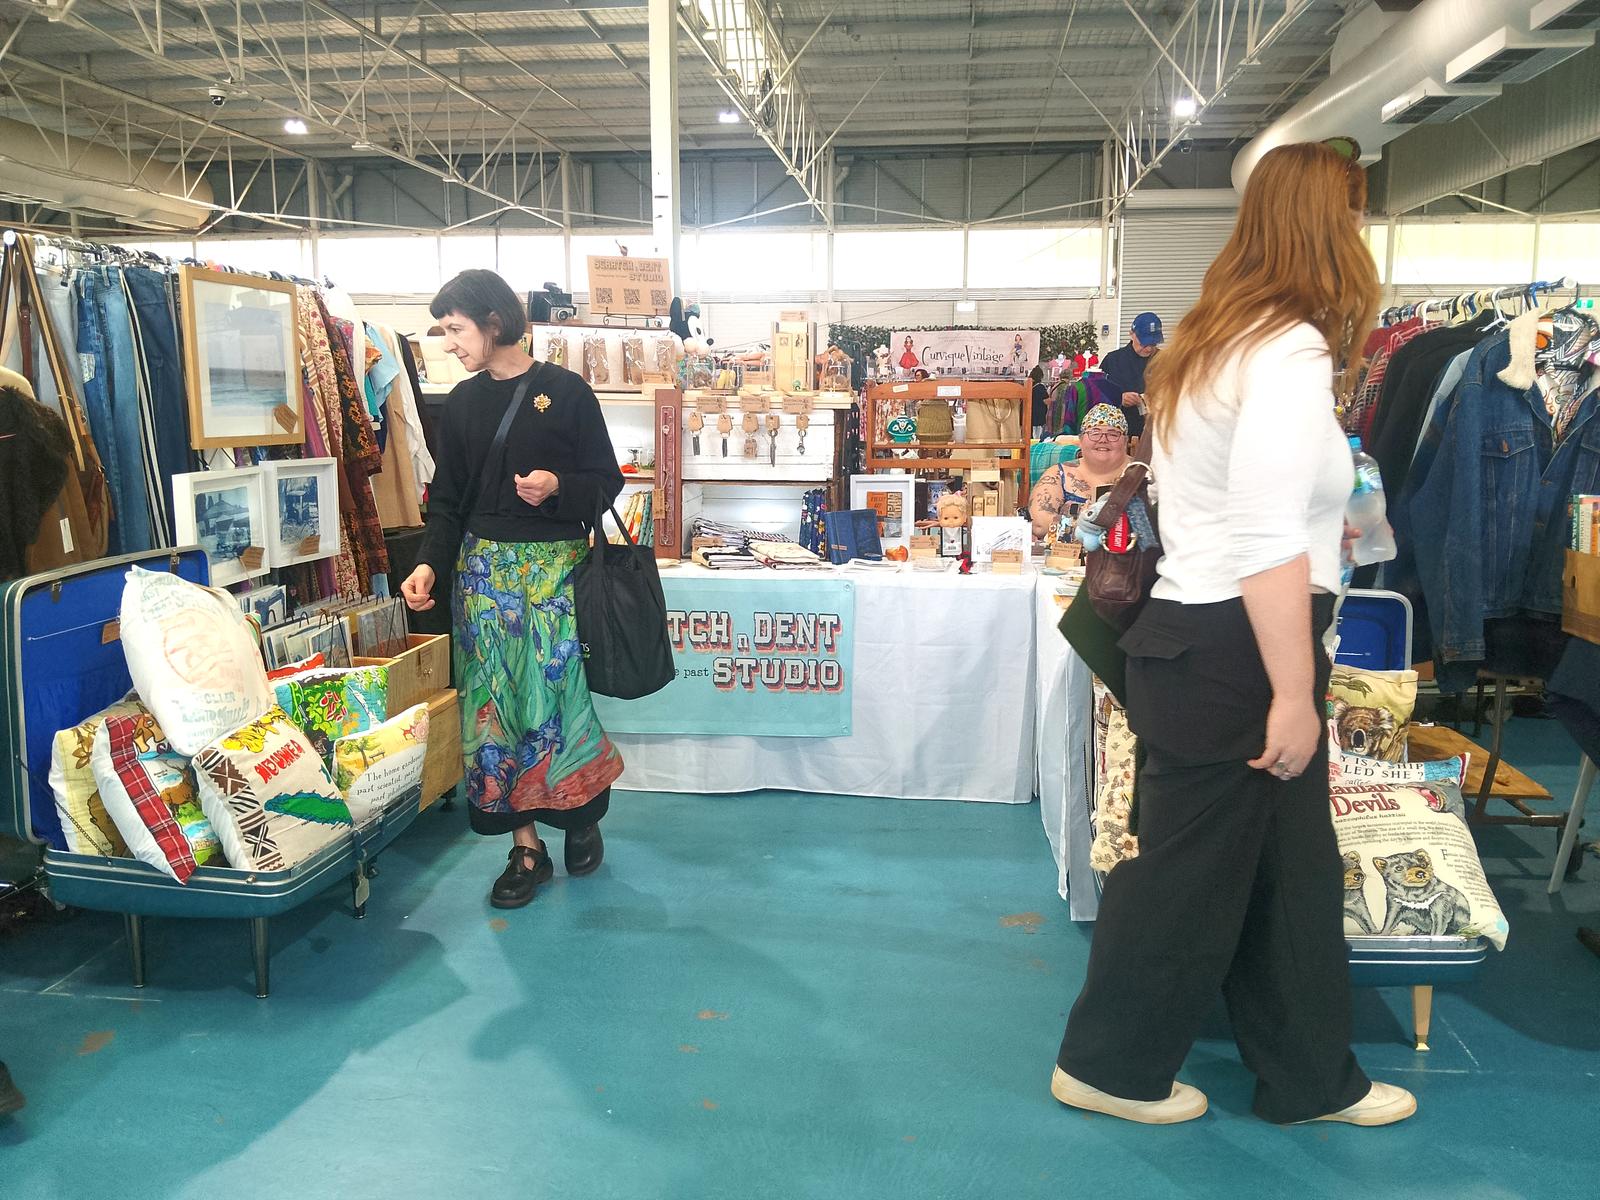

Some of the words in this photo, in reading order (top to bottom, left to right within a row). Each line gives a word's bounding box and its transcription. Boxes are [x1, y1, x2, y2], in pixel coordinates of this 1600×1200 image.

[639, 261, 662, 272] DENT
[629, 273, 663, 282] STUDIO
[921, 346, 966, 367] Curvique
[965, 345, 1004, 363] Vintage
[754, 612, 841, 651] DENT
[684, 667, 709, 679] past
[712, 657, 843, 691] STUDIO
[1355, 757, 1368, 767] IS
[365, 772, 382, 782] The
[383, 768, 400, 778] home
[1382, 770, 1411, 780] SHE
[1417, 771, 1424, 781] ?
[357, 784, 375, 796] part
[371, 792, 386, 804] part
[1329, 793, 1401, 817] Devils
